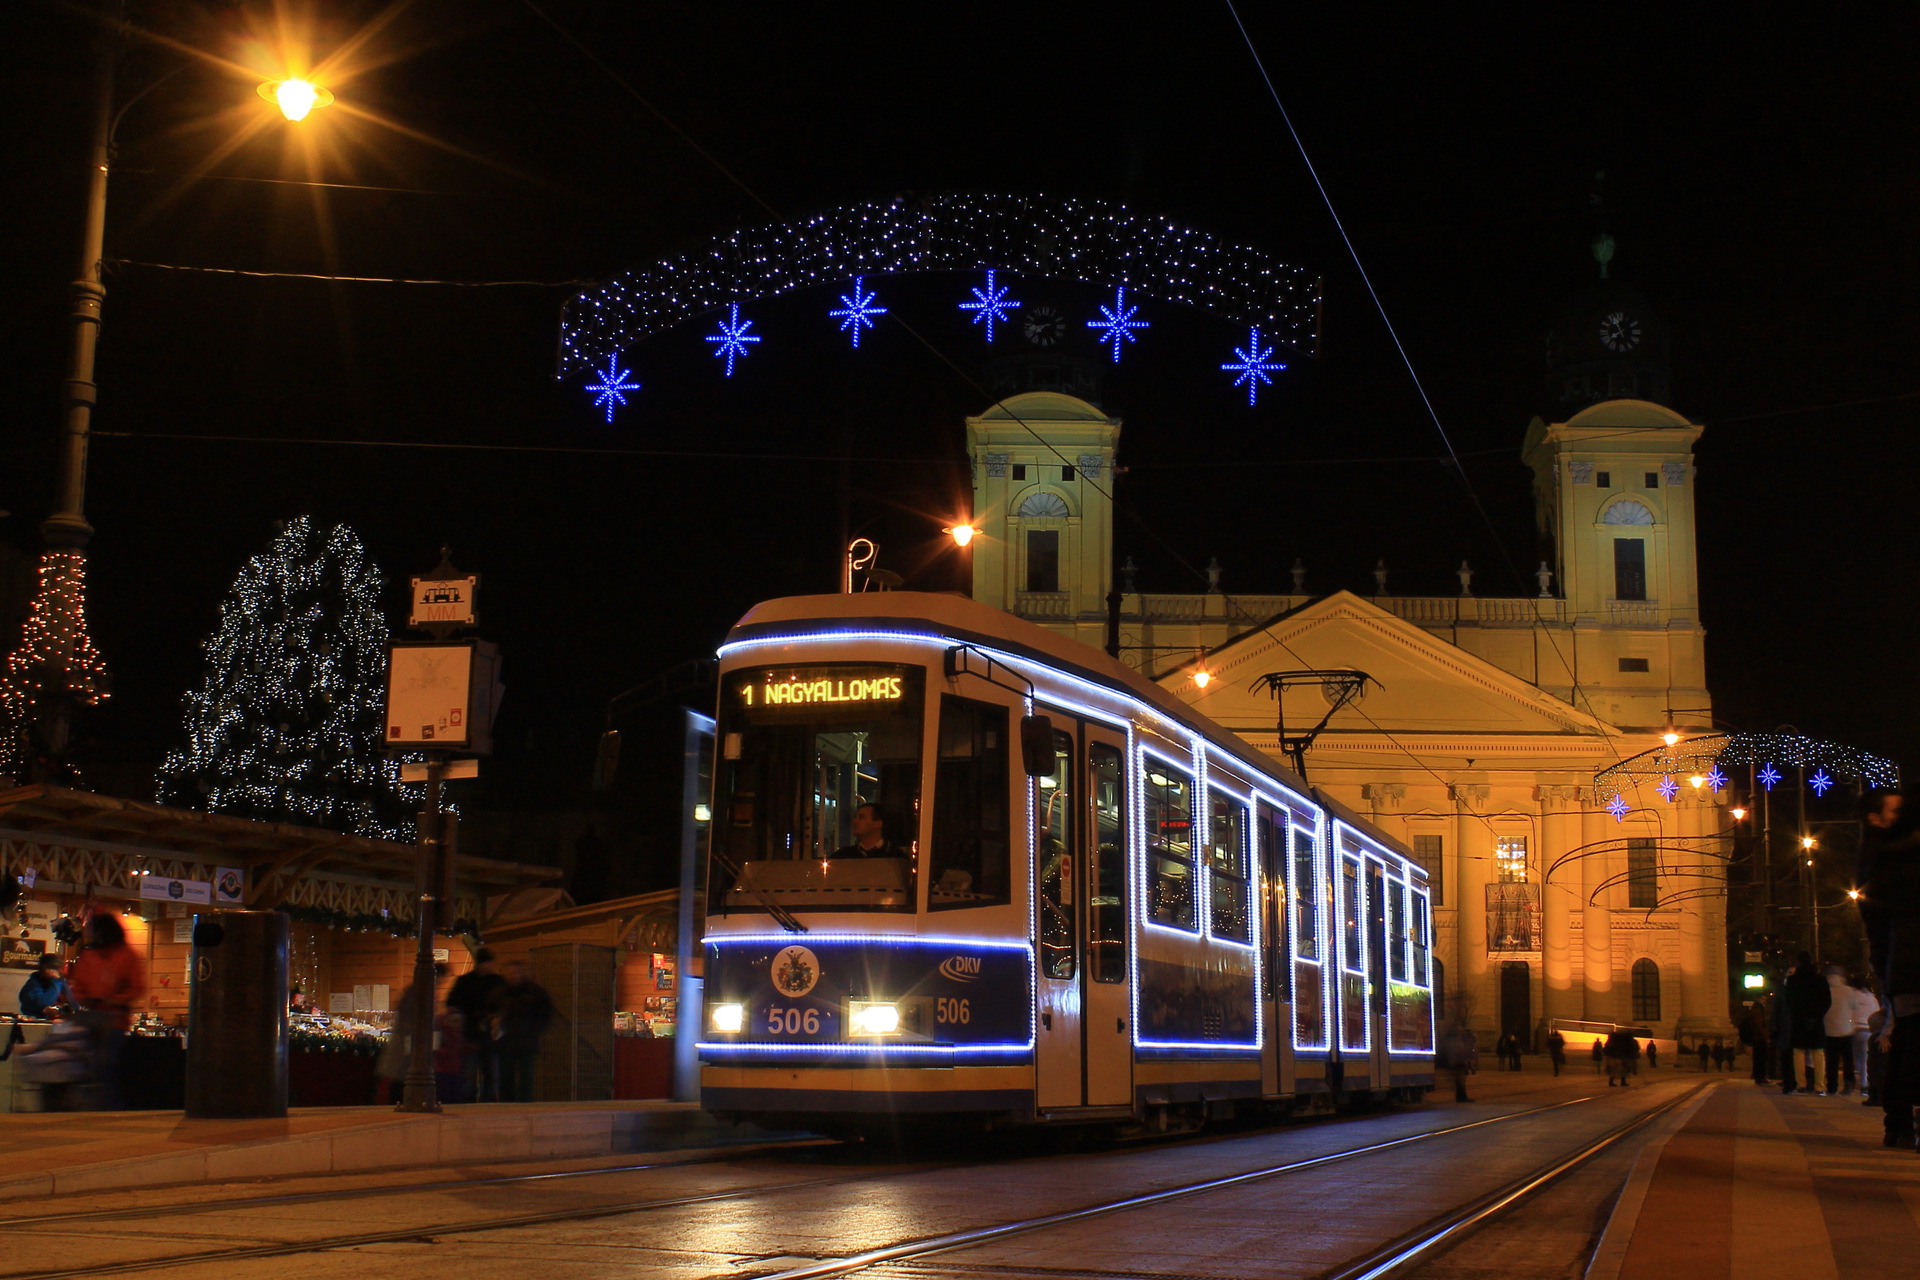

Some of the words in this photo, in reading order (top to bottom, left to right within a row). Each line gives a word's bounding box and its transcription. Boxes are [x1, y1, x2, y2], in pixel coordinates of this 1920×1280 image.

[742, 685, 753, 706] 1
[955, 956, 981, 974] DKV
[767, 1008, 820, 1035] 506
[937, 998, 970, 1024] 506
